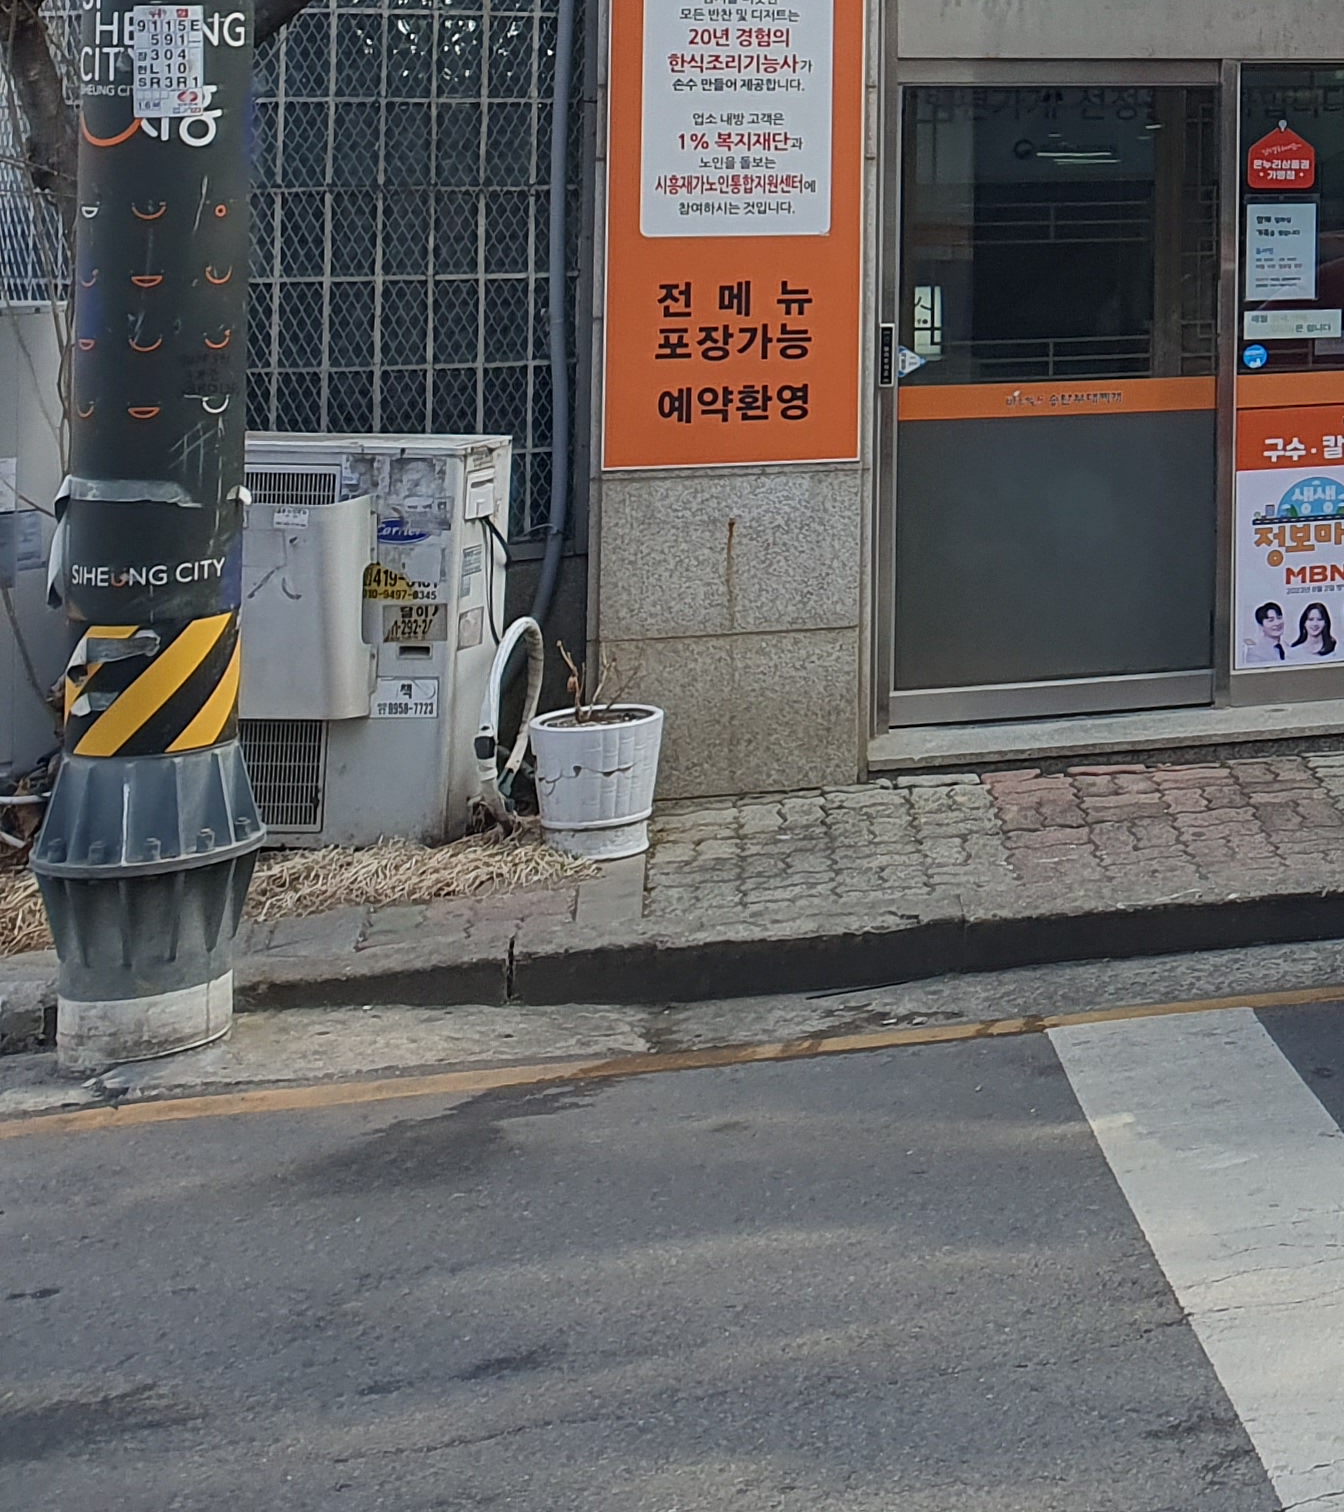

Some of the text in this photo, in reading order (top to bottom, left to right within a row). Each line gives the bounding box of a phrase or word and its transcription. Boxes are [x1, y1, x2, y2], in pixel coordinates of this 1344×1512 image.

[679, 8, 800, 23] 모든 반찬 및 디저트는
[136, 19, 200, 32] 9115E
[151, 34, 186, 46] 591
[688, 28, 791, 48] 20년 경험의
[668, 54, 813, 74] 한식조리기능사가
[138, 76, 198, 89] SR3R1
[672, 78, 805, 93] 손수 만들어 제공합니다.
[692, 113, 785, 126] 업소 내방 고객은
[678, 131, 803, 152] 1% 복지재단과
[699, 156, 777, 170] 노인을 돌보는
[655, 174, 816, 194] 시흥재가노인통합지원센터에
[678, 202, 796, 215] 참여하시는 것입니다.
[654, 323, 813, 361] 포장가능
[658, 384, 809, 423] 예약환영
[176, 557, 226, 584] CITY
